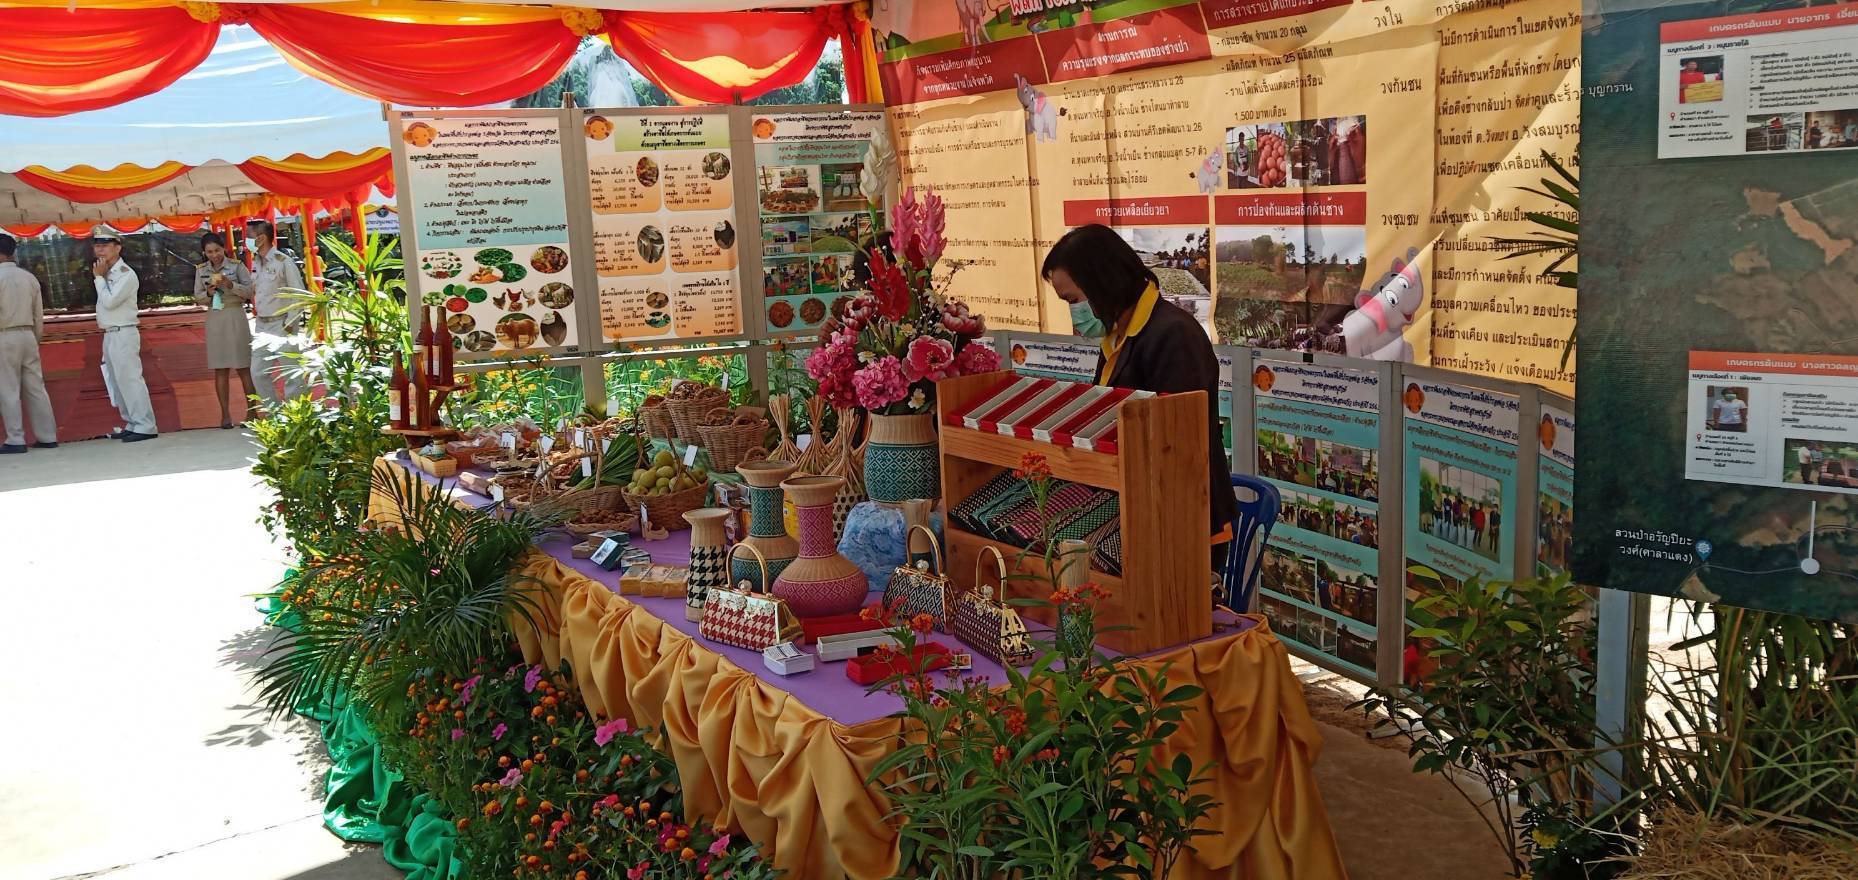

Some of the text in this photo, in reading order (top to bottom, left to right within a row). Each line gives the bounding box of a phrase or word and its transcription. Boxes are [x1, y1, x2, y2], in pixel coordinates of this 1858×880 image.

[1374, 6, 1403, 28] วงใน
[1280, 27, 1289, 38] 20
[1283, 53, 1296, 63] 25
[1381, 76, 1422, 94] วงกันชน
[1381, 213, 1420, 229] วงชุมชน
